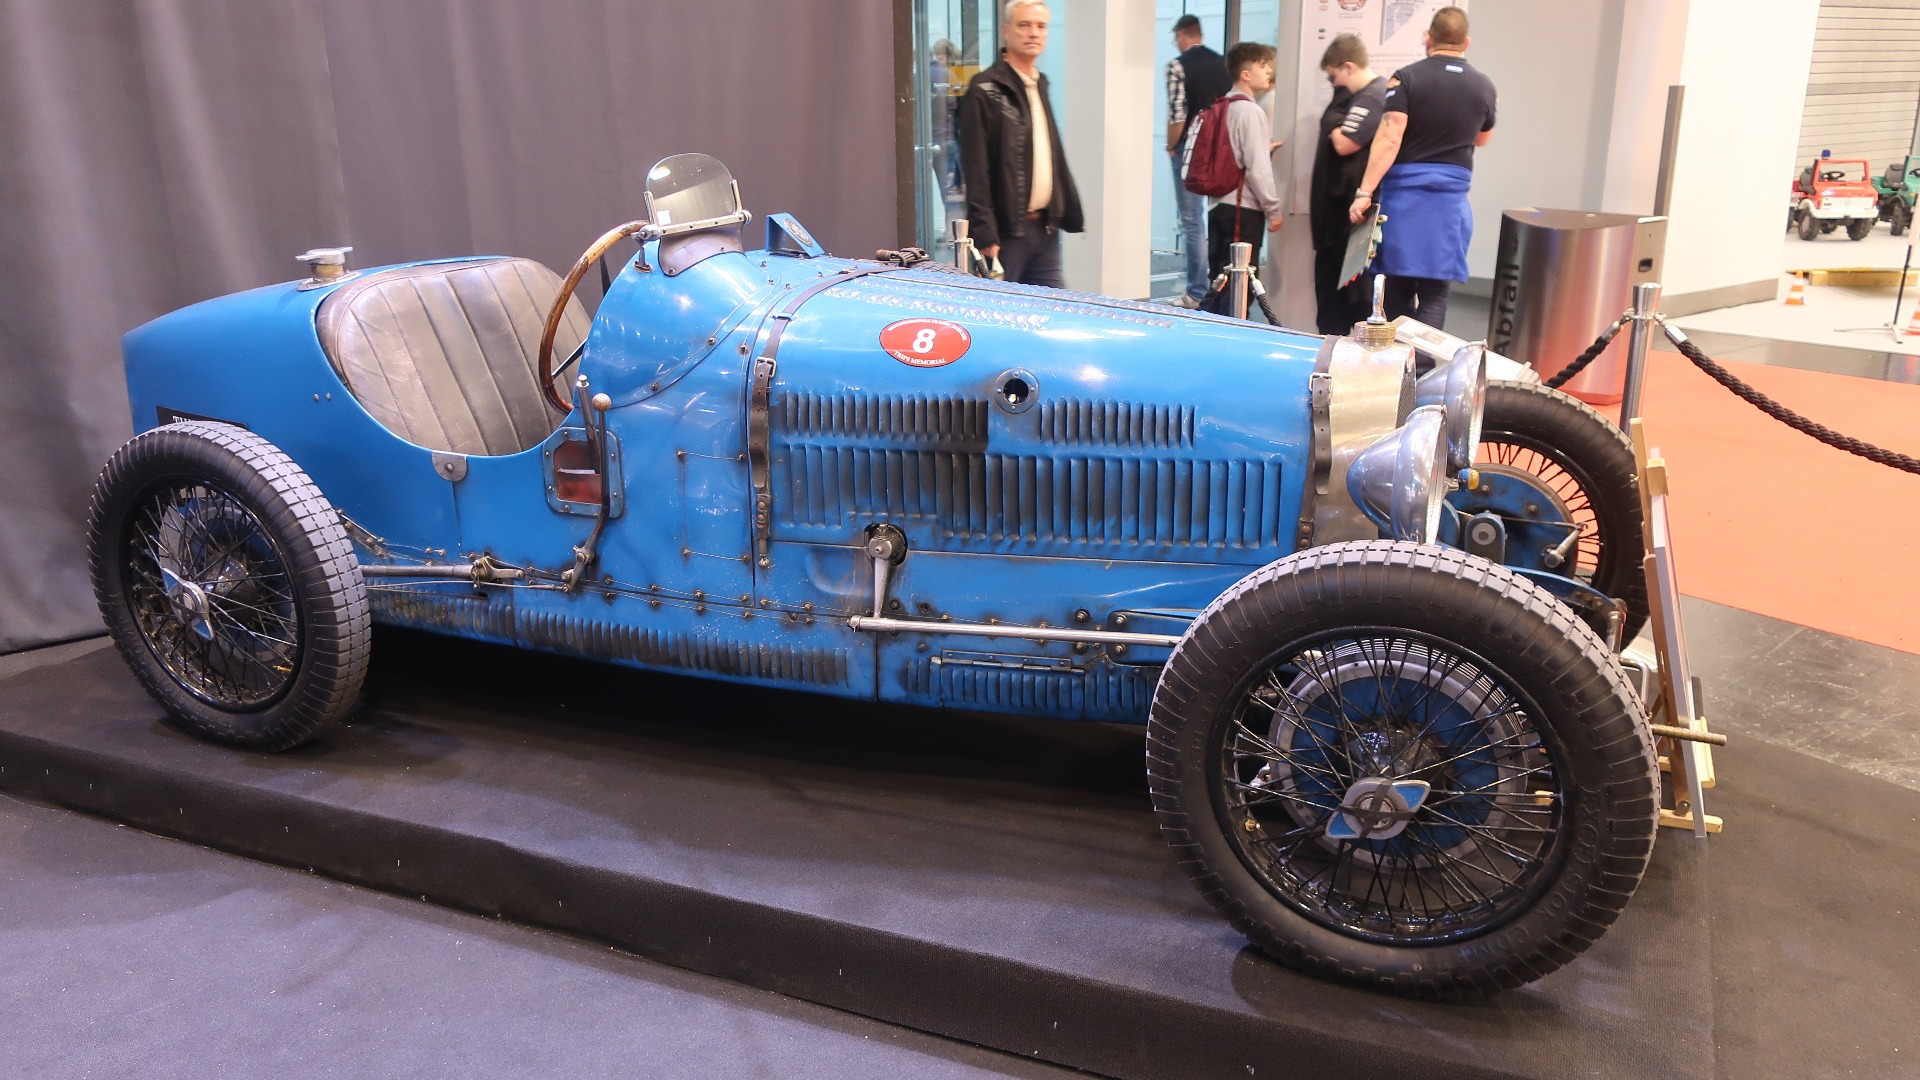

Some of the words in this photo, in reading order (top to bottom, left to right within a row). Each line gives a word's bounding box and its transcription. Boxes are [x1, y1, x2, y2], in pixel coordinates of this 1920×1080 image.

[1493, 262, 1520, 354] Abfall
[912, 328, 936, 354] 8
[894, 350, 911, 362] TRIPS
[911, 357, 947, 365] MEMORIAL
